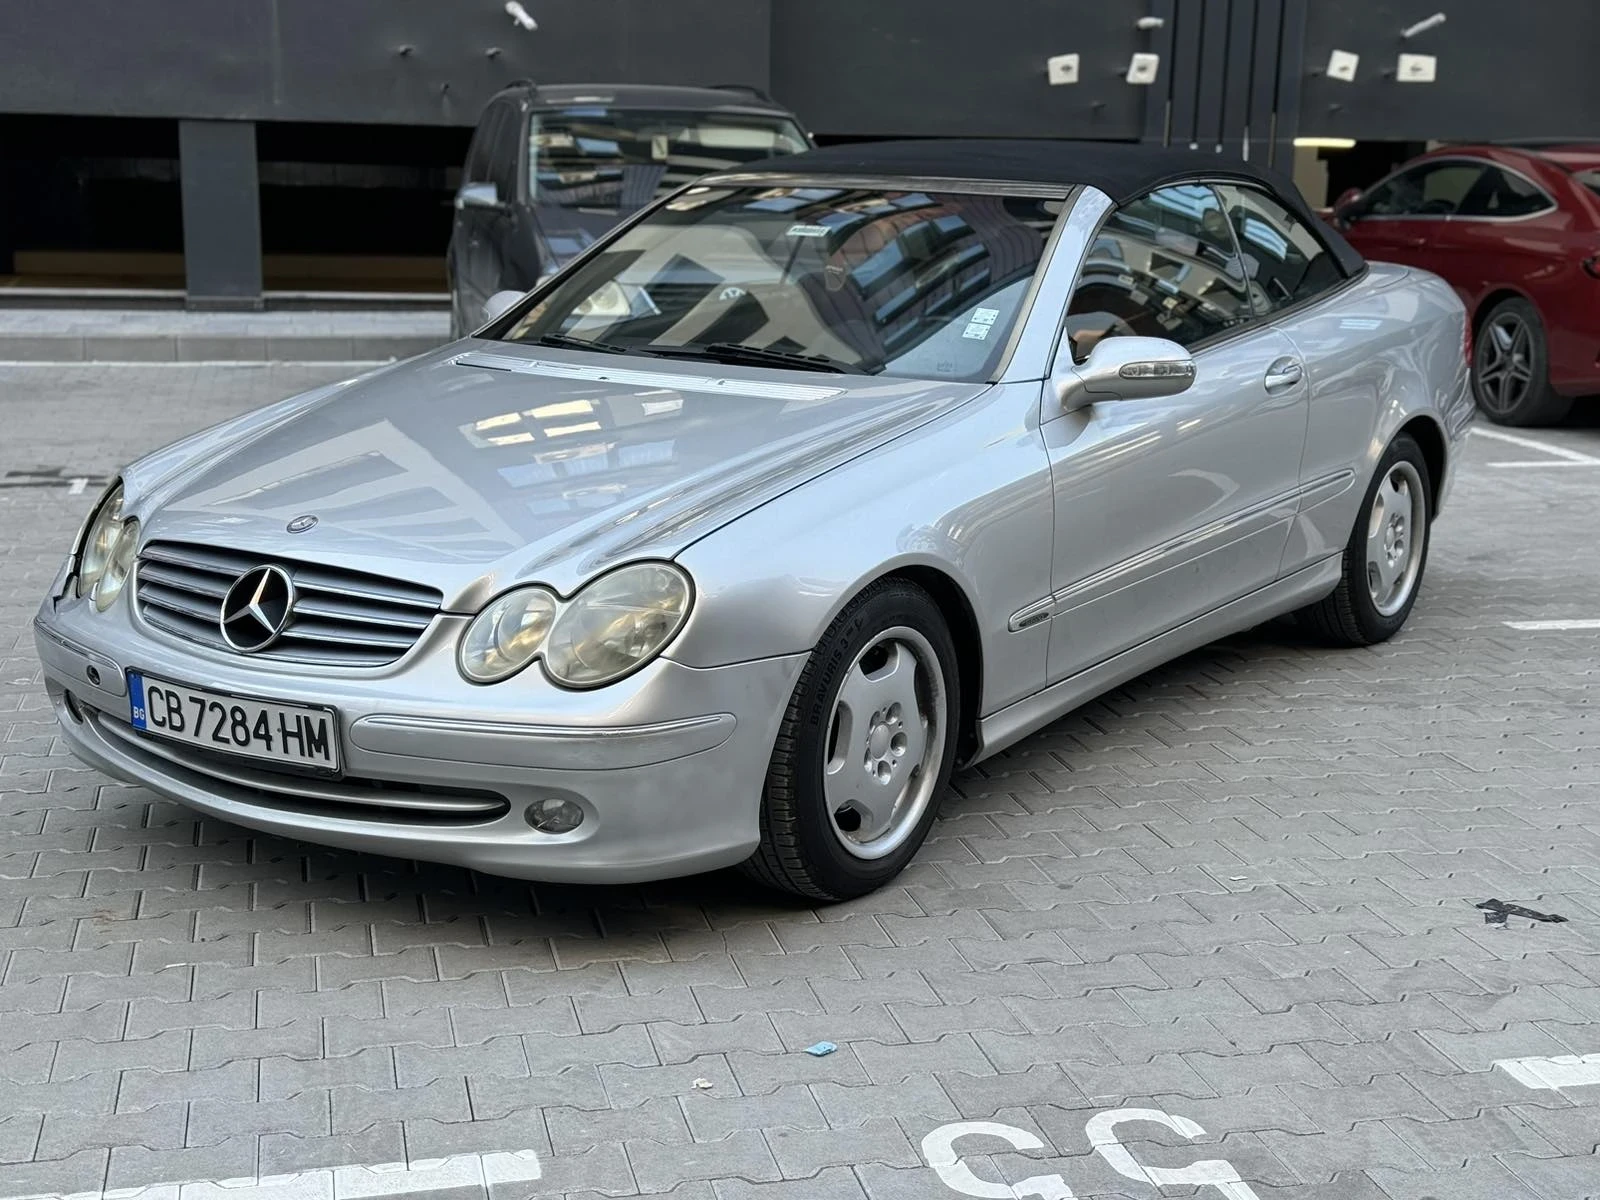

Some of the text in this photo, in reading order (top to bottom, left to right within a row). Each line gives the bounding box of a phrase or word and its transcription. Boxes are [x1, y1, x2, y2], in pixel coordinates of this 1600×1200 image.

[132, 705, 145, 721] BG
[147, 685, 331, 761] CB 7284 HM
